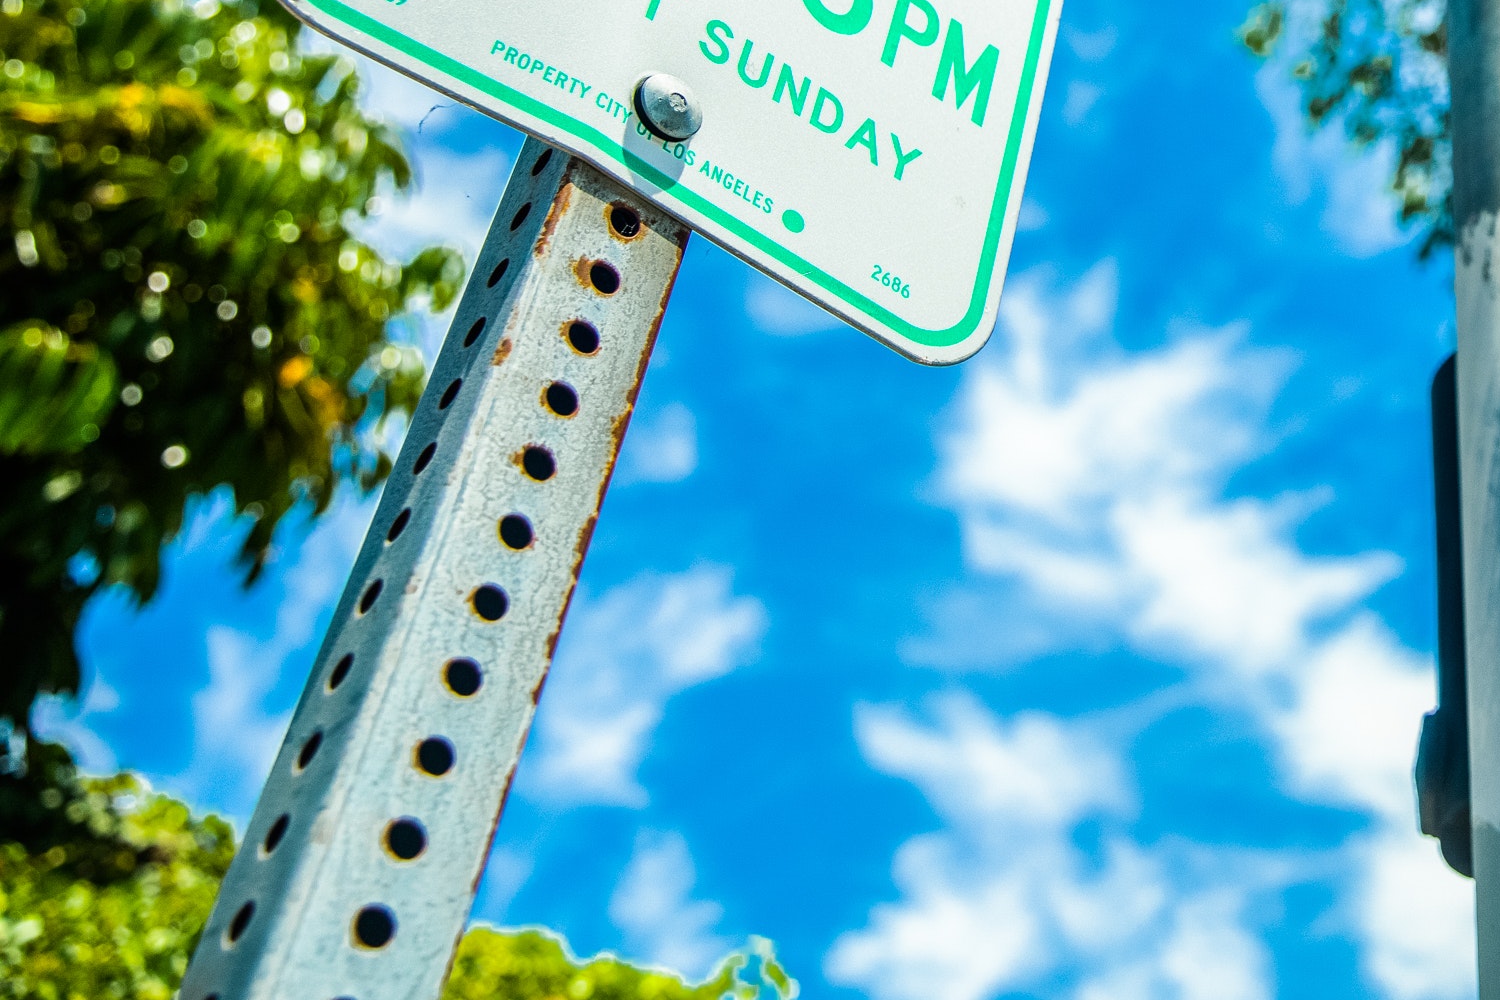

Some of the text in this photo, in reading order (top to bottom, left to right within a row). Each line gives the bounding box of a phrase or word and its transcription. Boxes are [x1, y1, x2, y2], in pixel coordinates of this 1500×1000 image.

[489, 39, 592, 100] PROPERTY
[594, 91, 634, 125] CITY
[661, 139, 697, 167] LOS
[698, 160, 774, 215] ANGELES
[697, 19, 923, 181] SUNDAY
[870, 263, 911, 299] 2686
